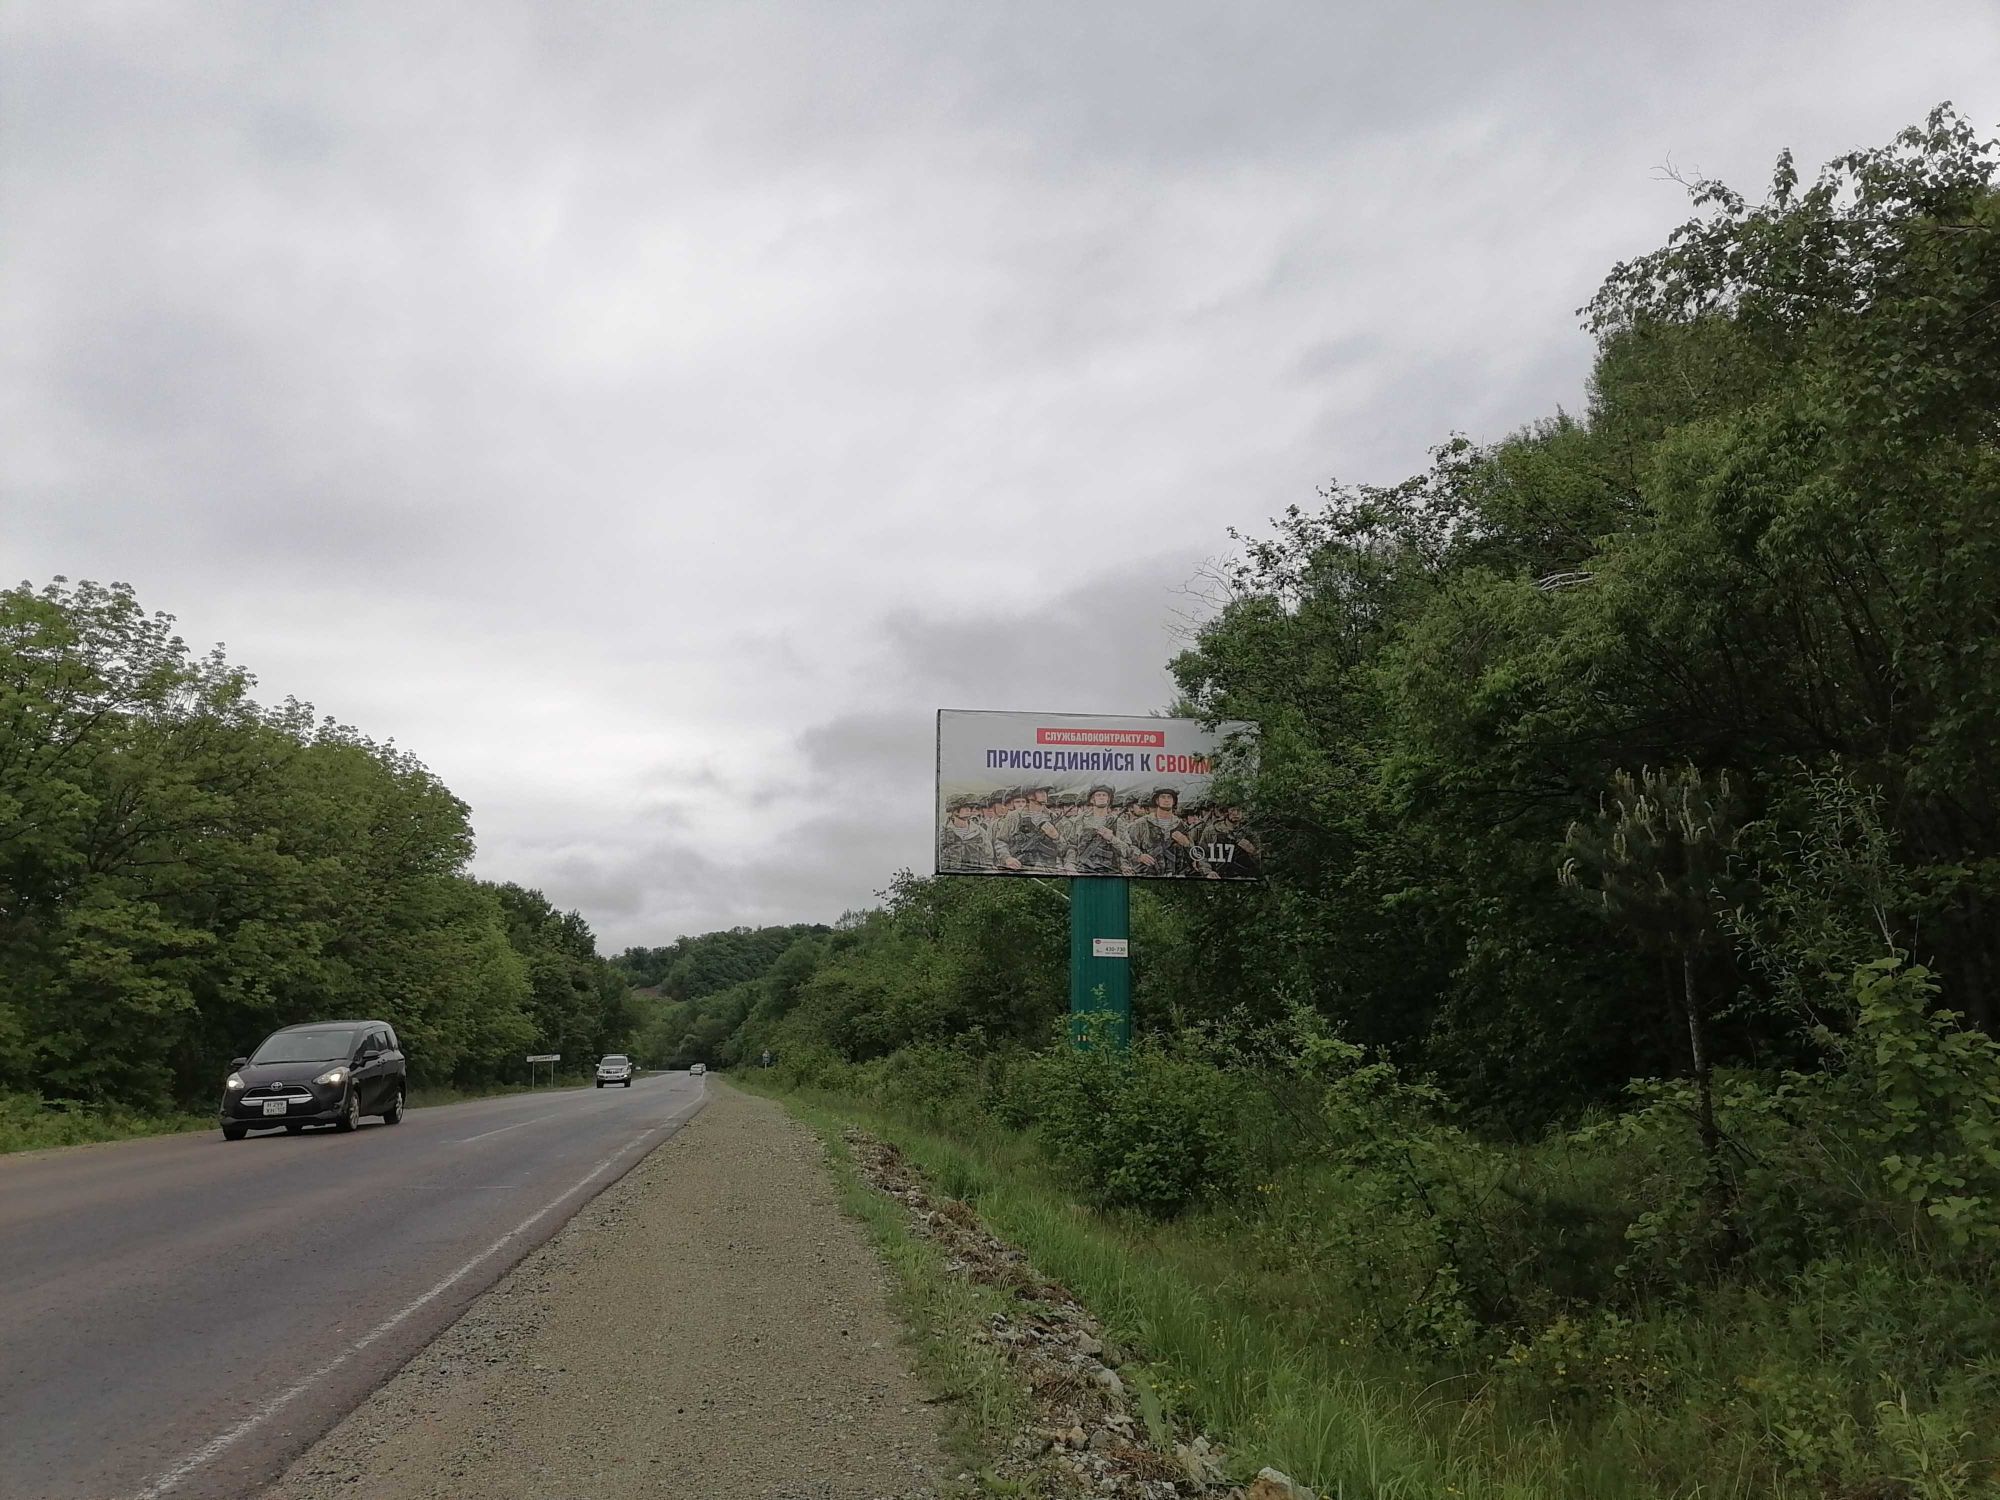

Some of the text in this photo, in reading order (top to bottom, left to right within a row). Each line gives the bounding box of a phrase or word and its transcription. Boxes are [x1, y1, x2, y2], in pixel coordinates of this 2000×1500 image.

[1045, 731, 1157, 744] СЛУЖБАПОКОНТРАКТУ.РФ
[987, 748, 1134, 772] ПРИСОЕДИНЯЙСЯ
[1141, 754, 1151, 772] К
[1208, 843, 1235, 863] 117
